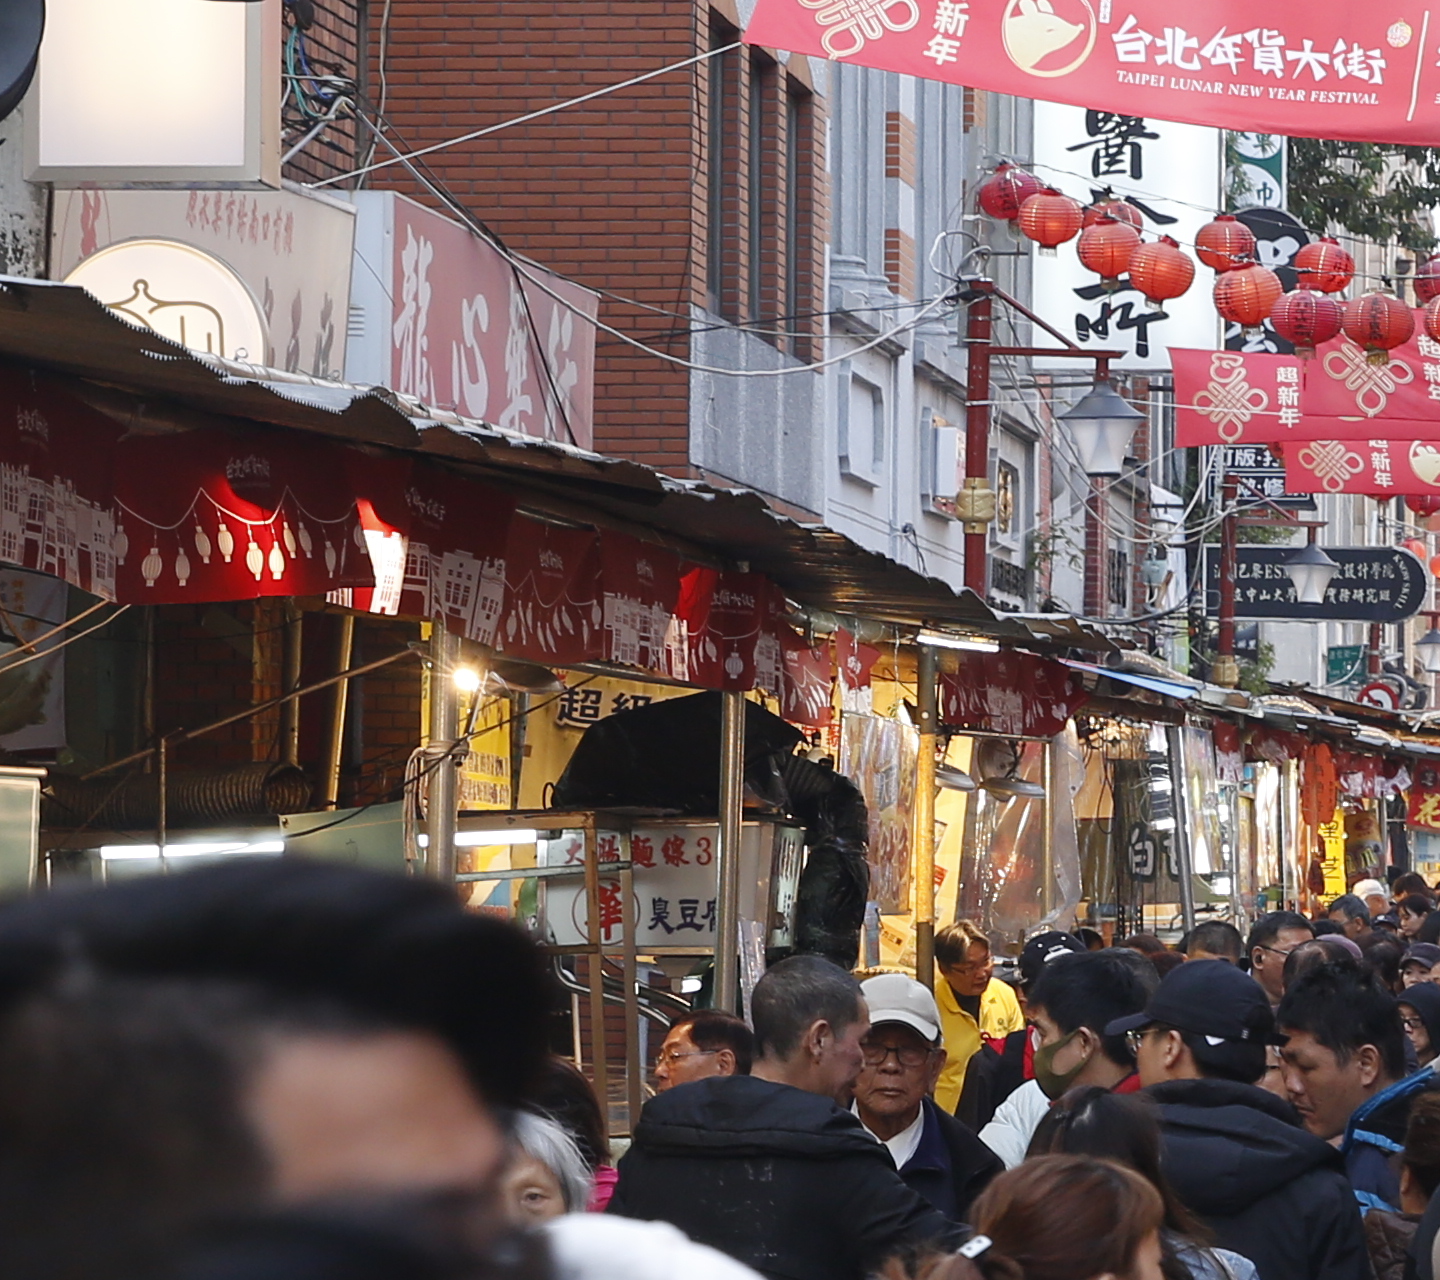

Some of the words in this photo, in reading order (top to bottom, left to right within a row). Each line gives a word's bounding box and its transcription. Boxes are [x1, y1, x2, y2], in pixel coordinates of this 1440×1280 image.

[1110, 13, 1387, 85] 台北年貨大街
[1115, 69, 1166, 88] TAIPEI
[1169, 76, 1224, 95] LUNAR
[1227, 82, 1265, 99] NEW
[1266, 85, 1306, 102] YEAR
[1309, 88, 1380, 106] FESTIVAL
